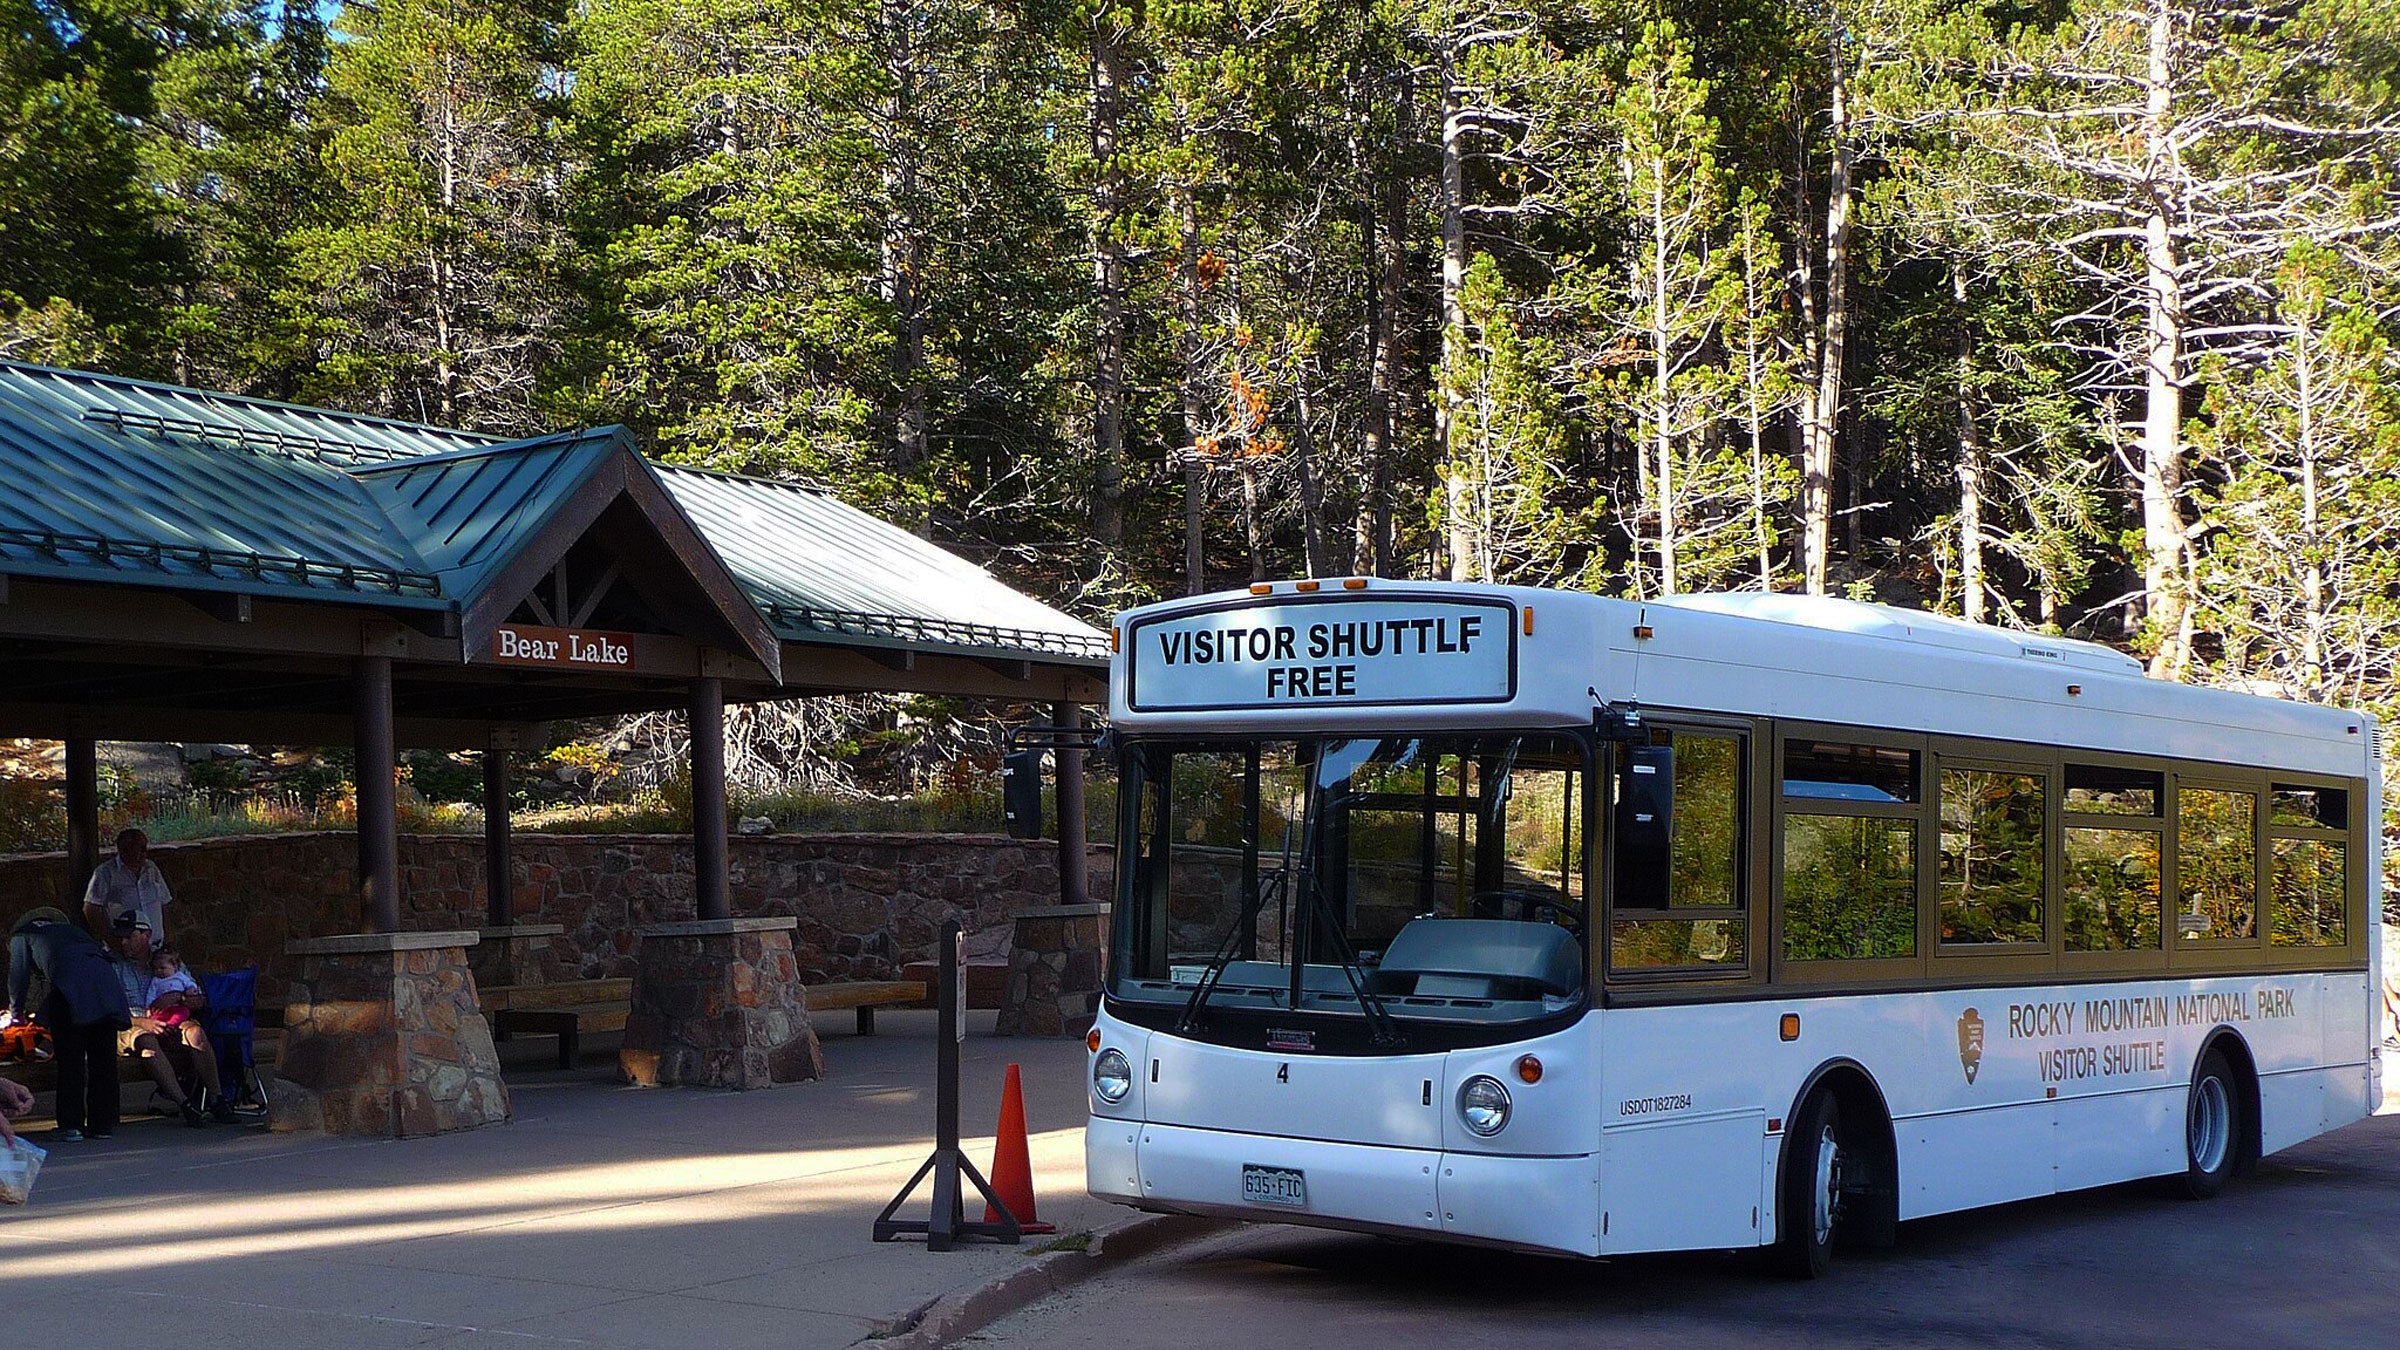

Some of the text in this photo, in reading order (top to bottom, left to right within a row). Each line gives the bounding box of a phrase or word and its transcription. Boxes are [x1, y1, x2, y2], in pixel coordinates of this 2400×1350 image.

[498, 630, 628, 664] Bear Lake
[1159, 626, 1296, 665] VISITOR
[1267, 665, 1356, 698] FREE
[2009, 1002, 2076, 1038] ROCKY
[2085, 996, 2168, 1033] MOUNTAIN
[2176, 992, 2251, 1025] NATIONAL
[2258, 988, 2295, 1019] PARK
[1277, 1063, 1289, 1083] 4
[2039, 1041, 2164, 1082] VISITOR SHUTTLE
[1620, 1094, 1691, 1116] USDOT1827284
